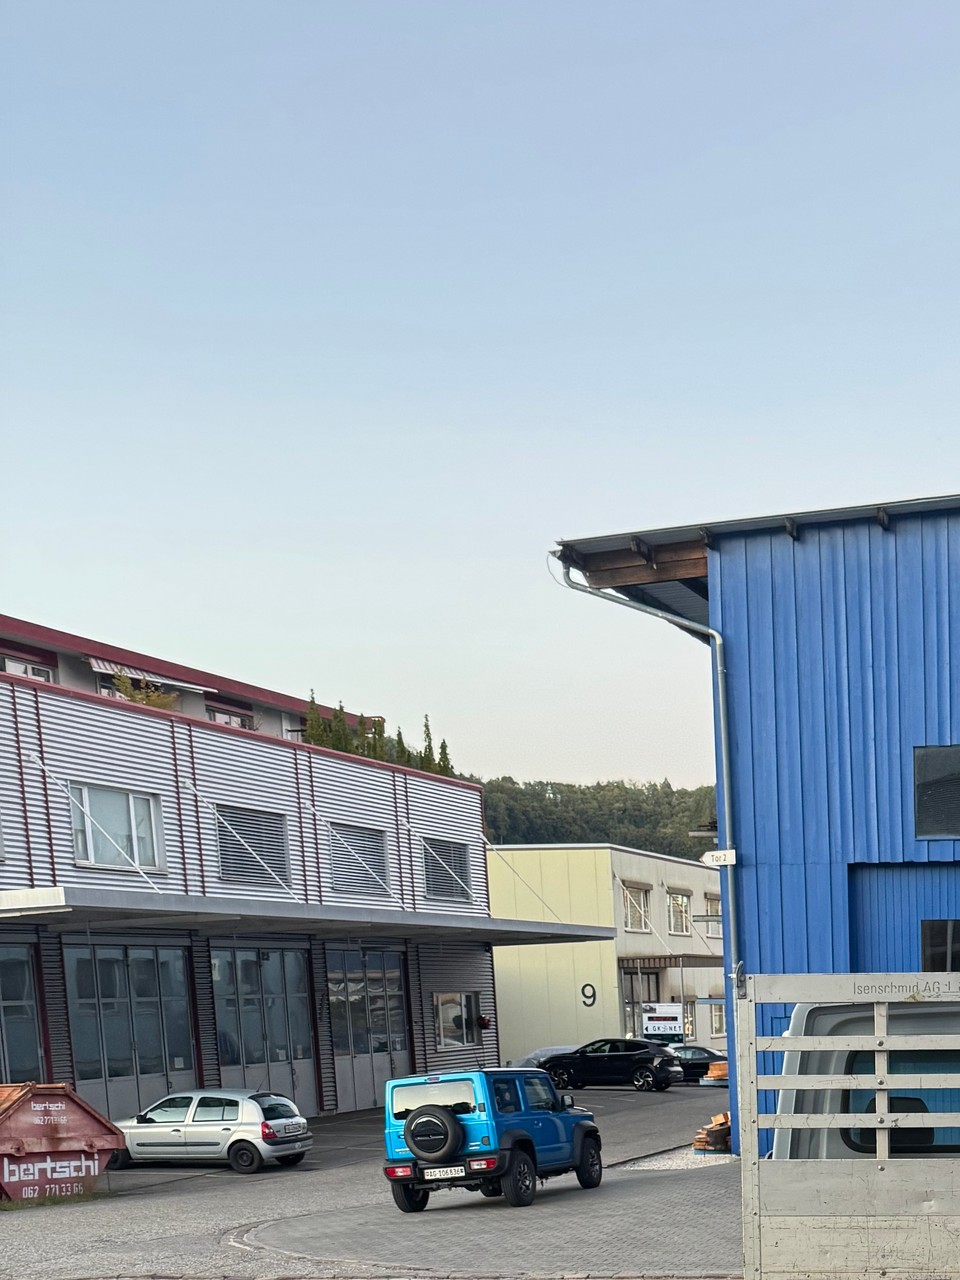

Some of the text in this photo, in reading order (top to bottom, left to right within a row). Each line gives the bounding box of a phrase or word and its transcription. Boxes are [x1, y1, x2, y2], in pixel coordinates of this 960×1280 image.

[581, 983, 597, 1008] 9
[853, 982, 919, 994] Isenschmid
[923, 981, 940, 993] AG
[31, 1101, 66, 1110] bertschi
[3, 1153, 99, 1182] bertschi
[22, 1182, 84, 1198] 062 771 33 66
